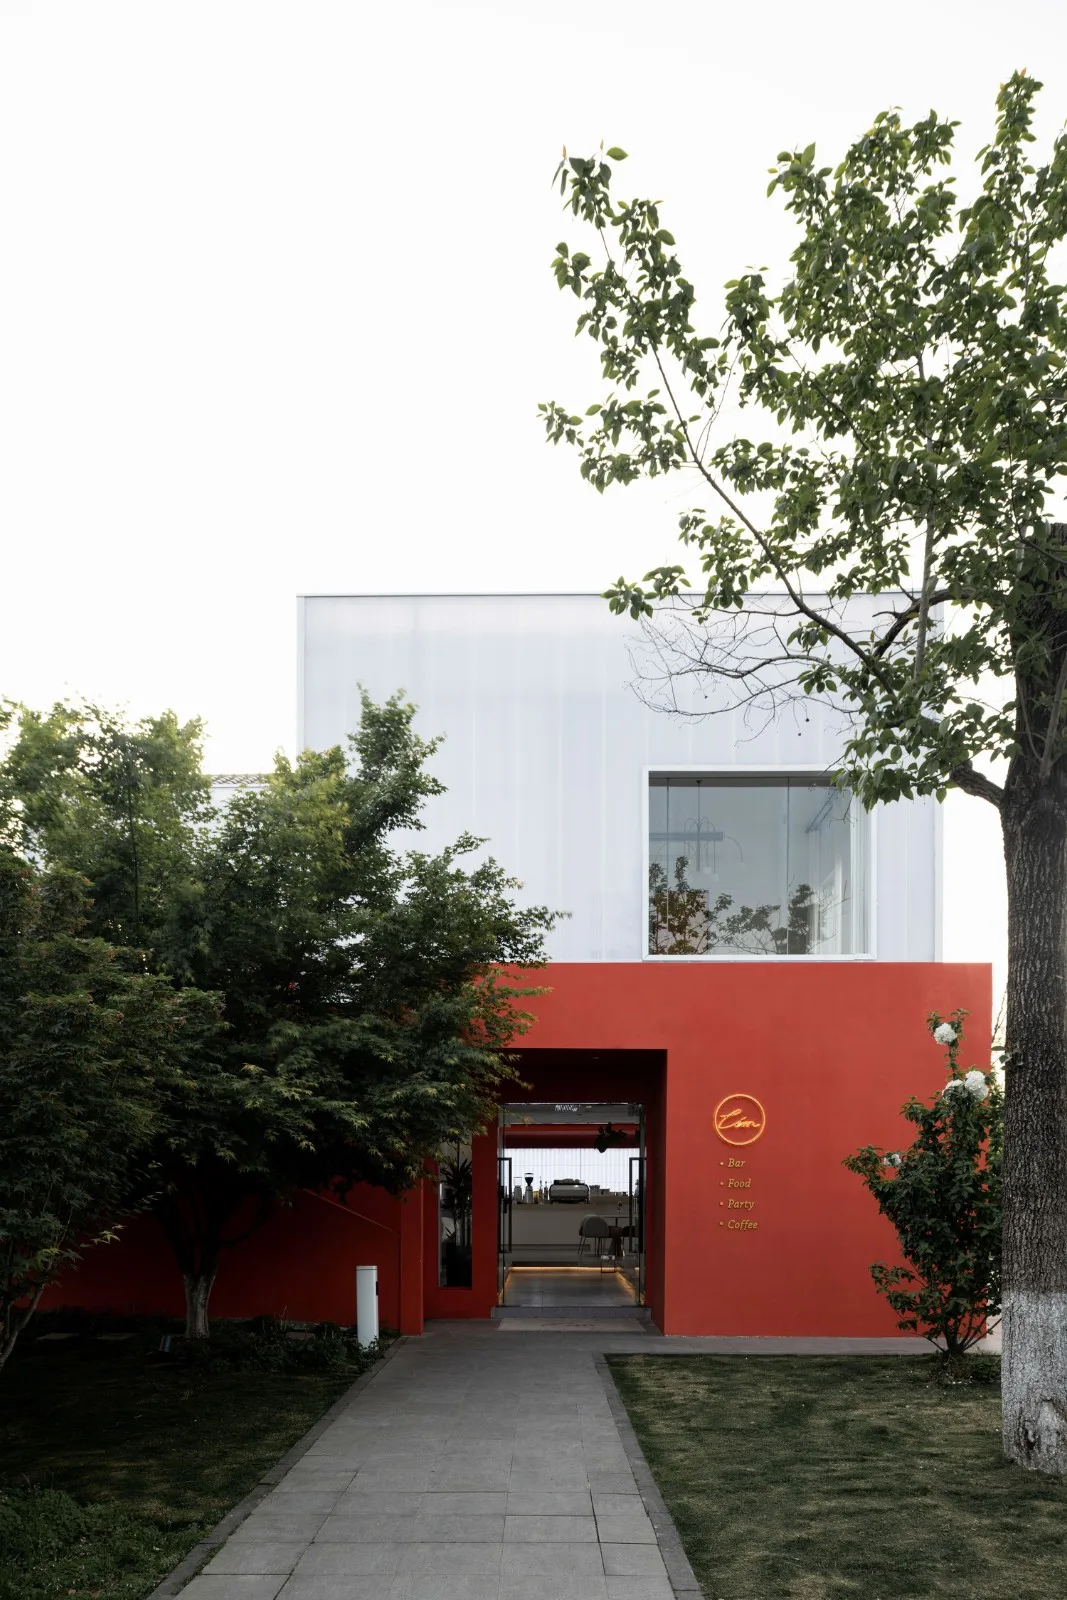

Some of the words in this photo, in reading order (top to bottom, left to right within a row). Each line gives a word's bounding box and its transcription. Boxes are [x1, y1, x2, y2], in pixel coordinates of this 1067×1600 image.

[727, 1158, 746, 1168] Bar
[727, 1178, 752, 1188] Food
[727, 1199, 755, 1211] Party
[727, 1220, 758, 1231] Coffee
